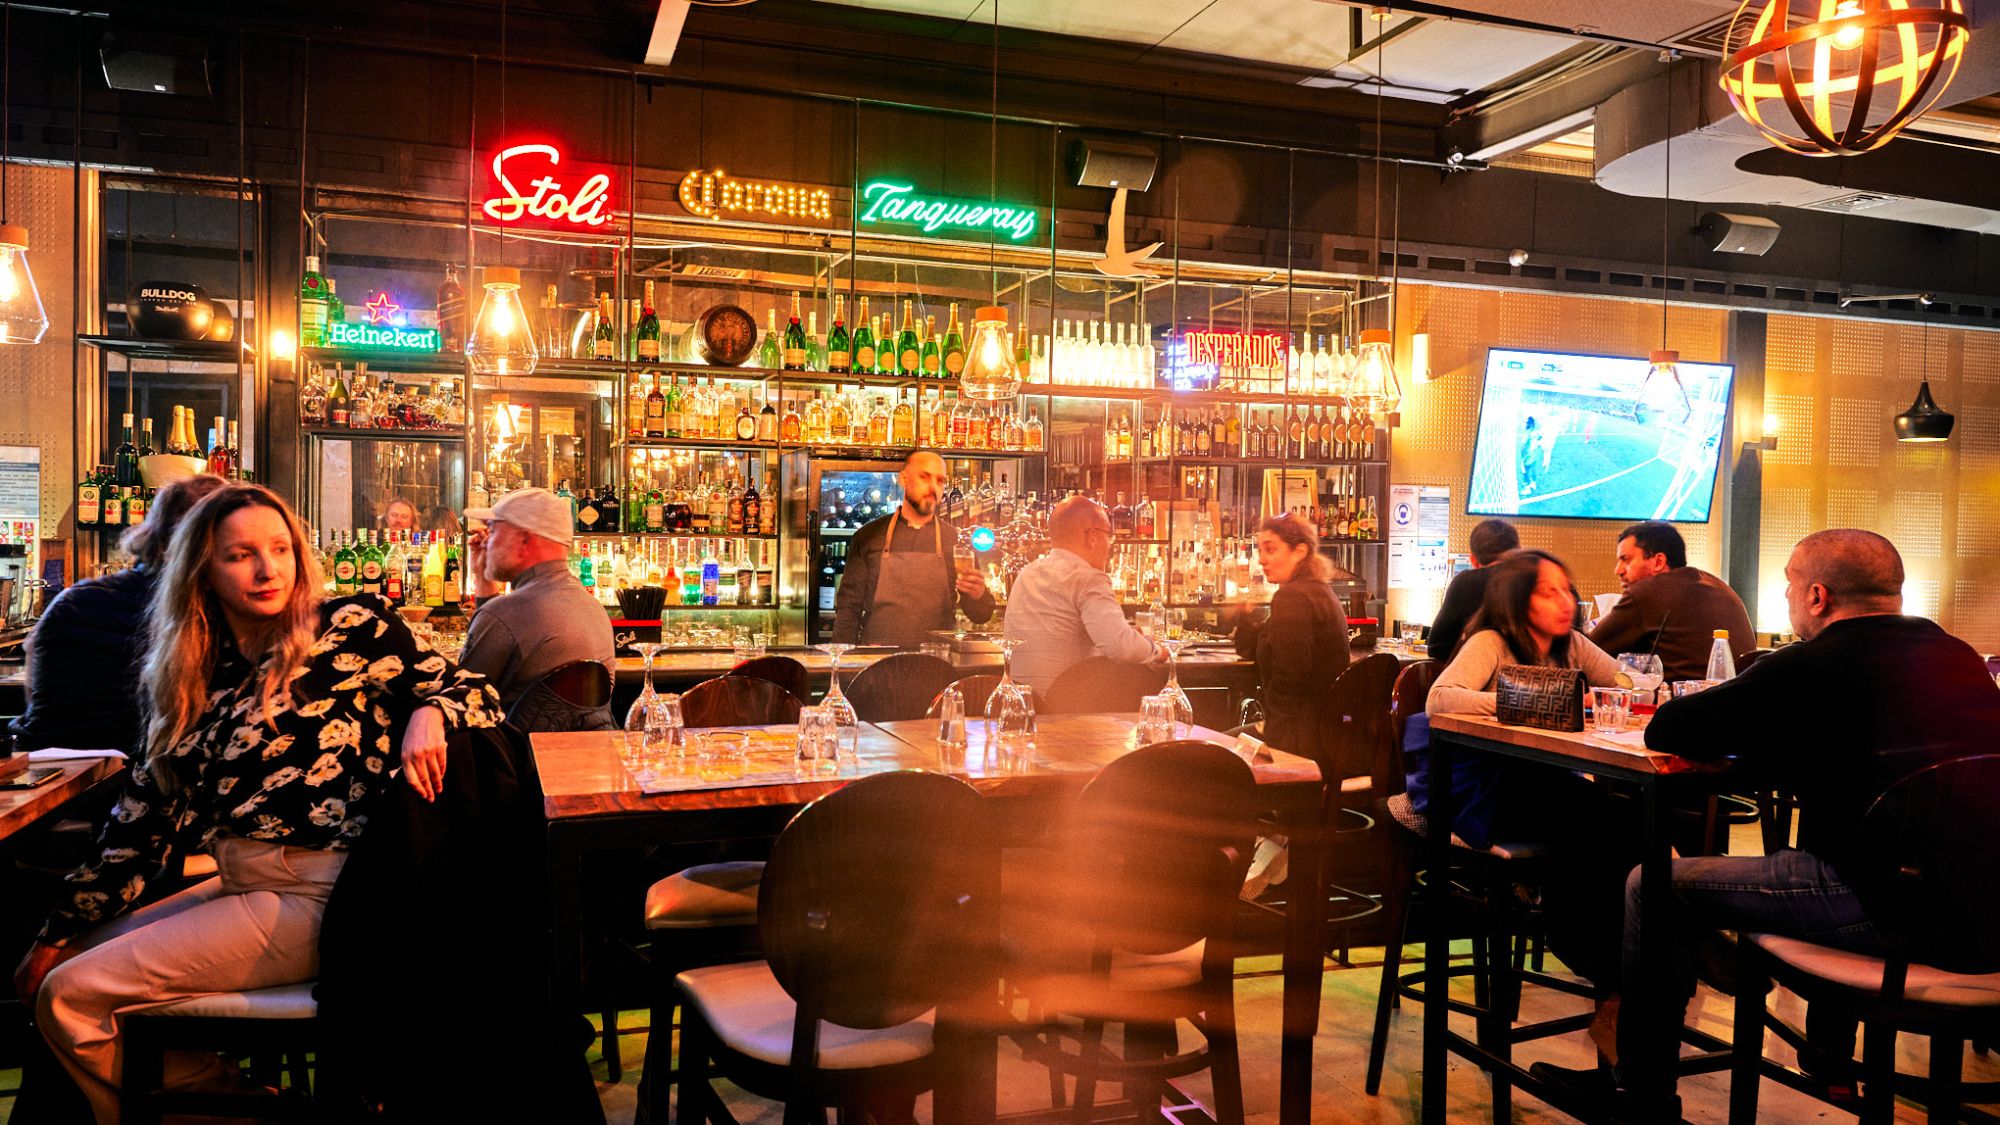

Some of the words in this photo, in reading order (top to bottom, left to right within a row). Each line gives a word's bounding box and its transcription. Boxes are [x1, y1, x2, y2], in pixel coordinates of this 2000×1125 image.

[678, 169, 832, 221] Corona
[861, 182, 1035, 239] Tanqueray
[141, 289, 195, 301] BULLDOG
[330, 323, 435, 349] Heineken
[1184, 331, 1282, 370] DESPERADOS
